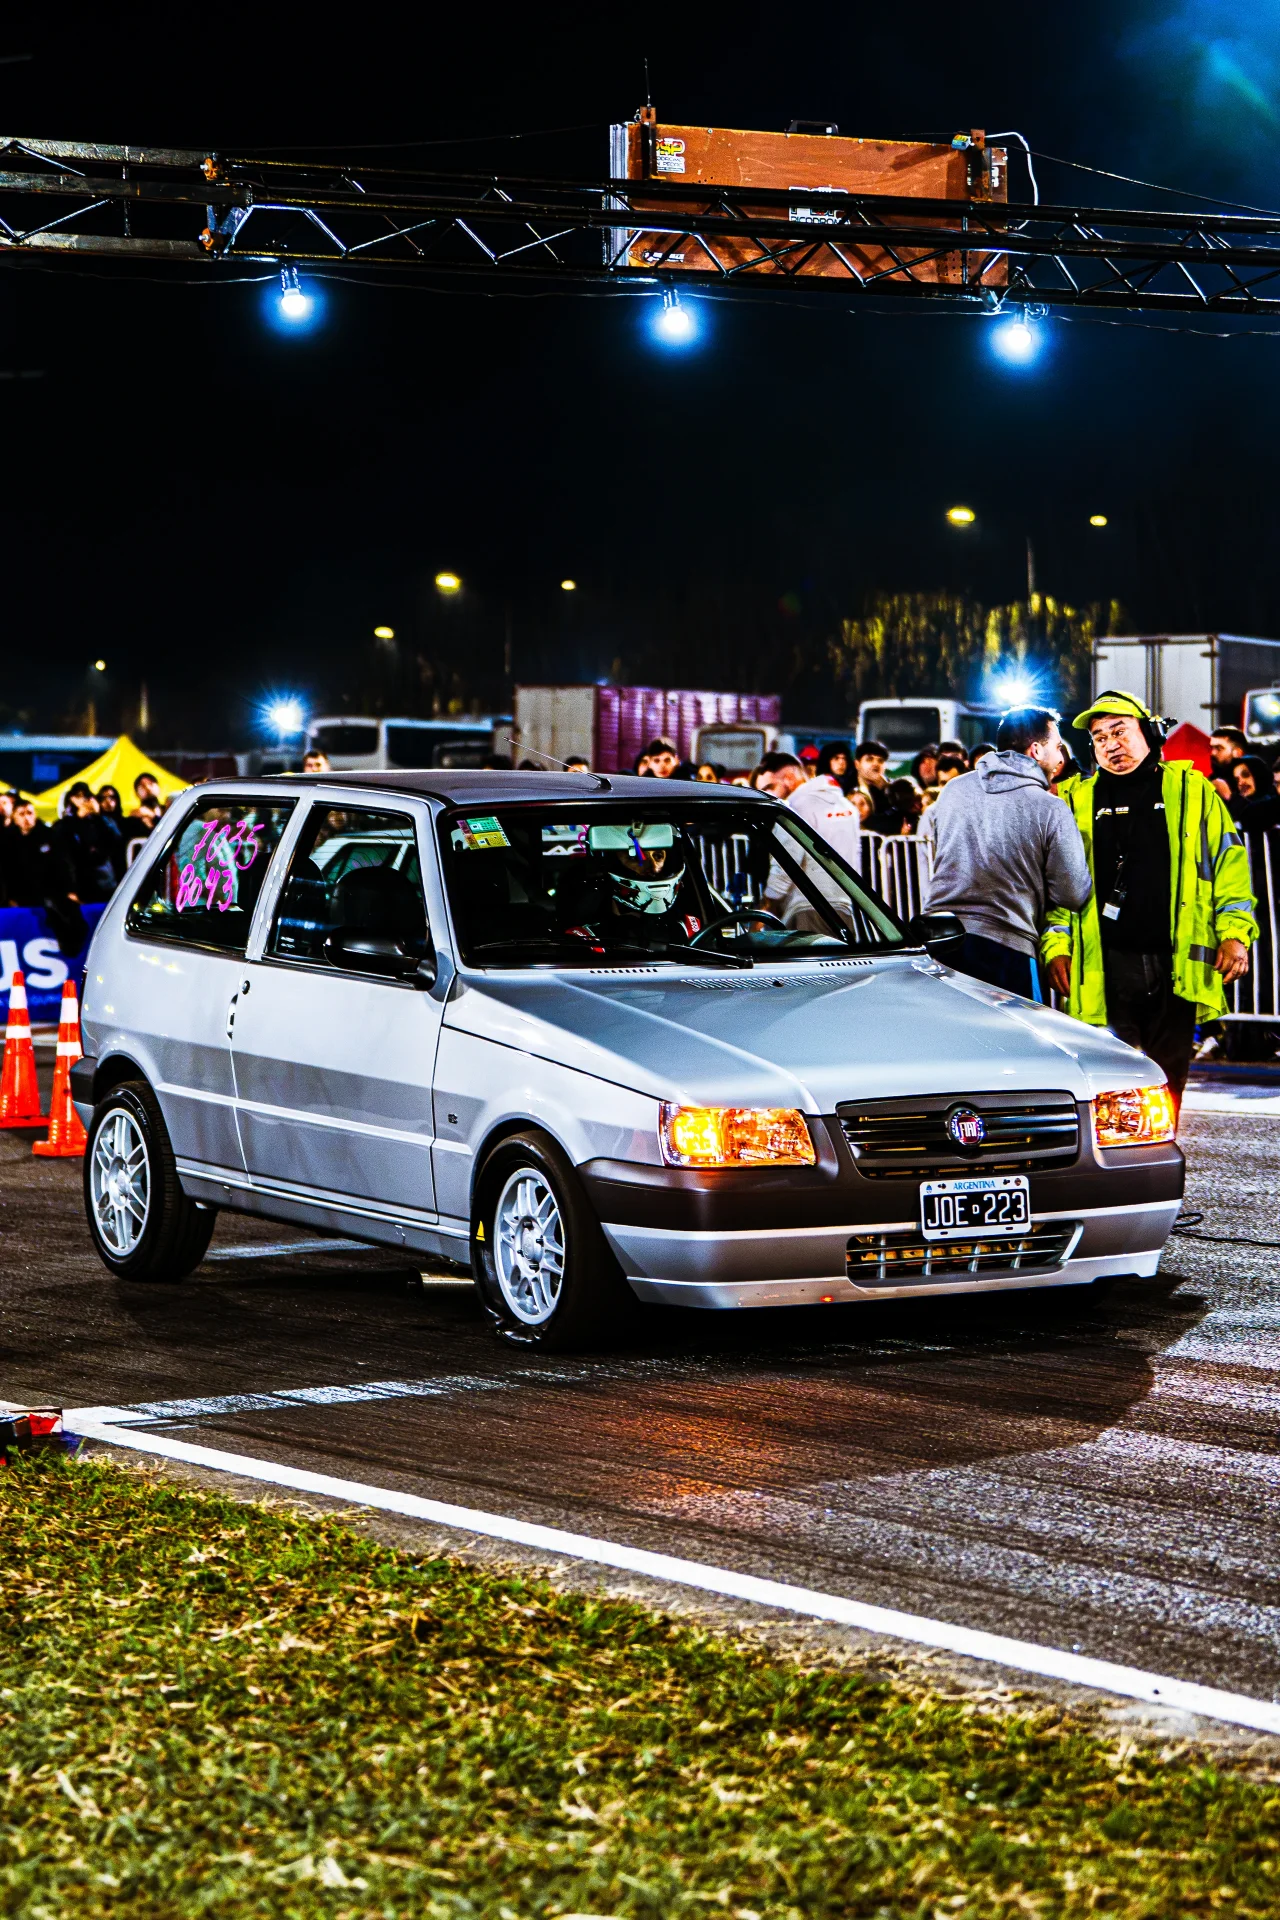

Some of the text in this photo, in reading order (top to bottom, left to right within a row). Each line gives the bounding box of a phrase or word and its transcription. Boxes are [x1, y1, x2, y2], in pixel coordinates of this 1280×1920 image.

[192, 819, 265, 870] 7035
[176, 863, 233, 912] 8043
[959, 1121, 978, 1138] FIAT
[953, 1180, 996, 1190] ARGENTINA
[927, 1195, 969, 1227] JOE
[983, 1191, 1025, 1224] 223
